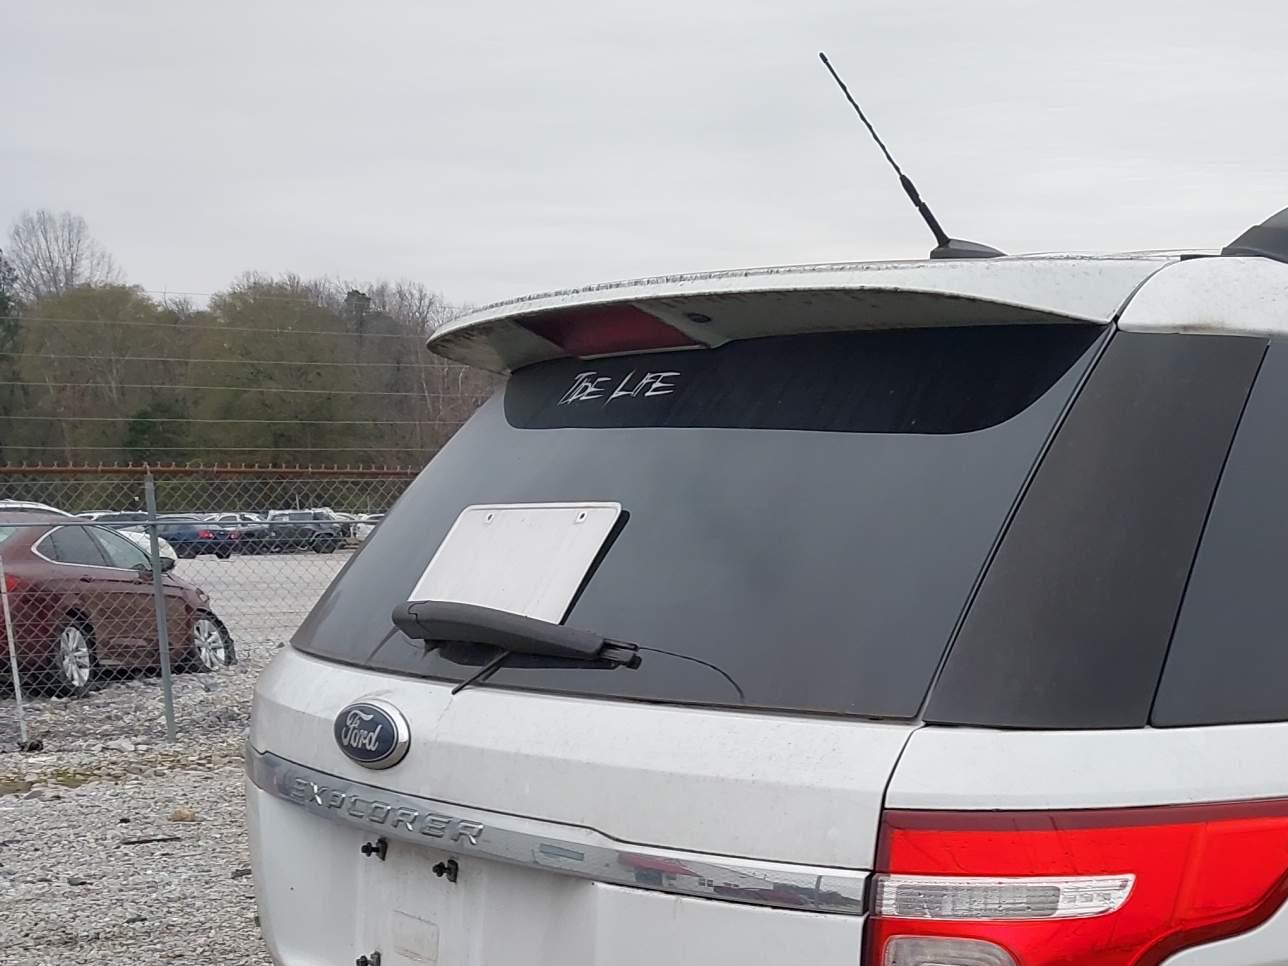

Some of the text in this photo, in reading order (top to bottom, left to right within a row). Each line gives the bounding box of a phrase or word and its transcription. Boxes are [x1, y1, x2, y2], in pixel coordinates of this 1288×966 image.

[603, 370, 681, 405] LIFE
[341, 709, 382, 751] Ford
[289, 778, 484, 845] EXPLORER
